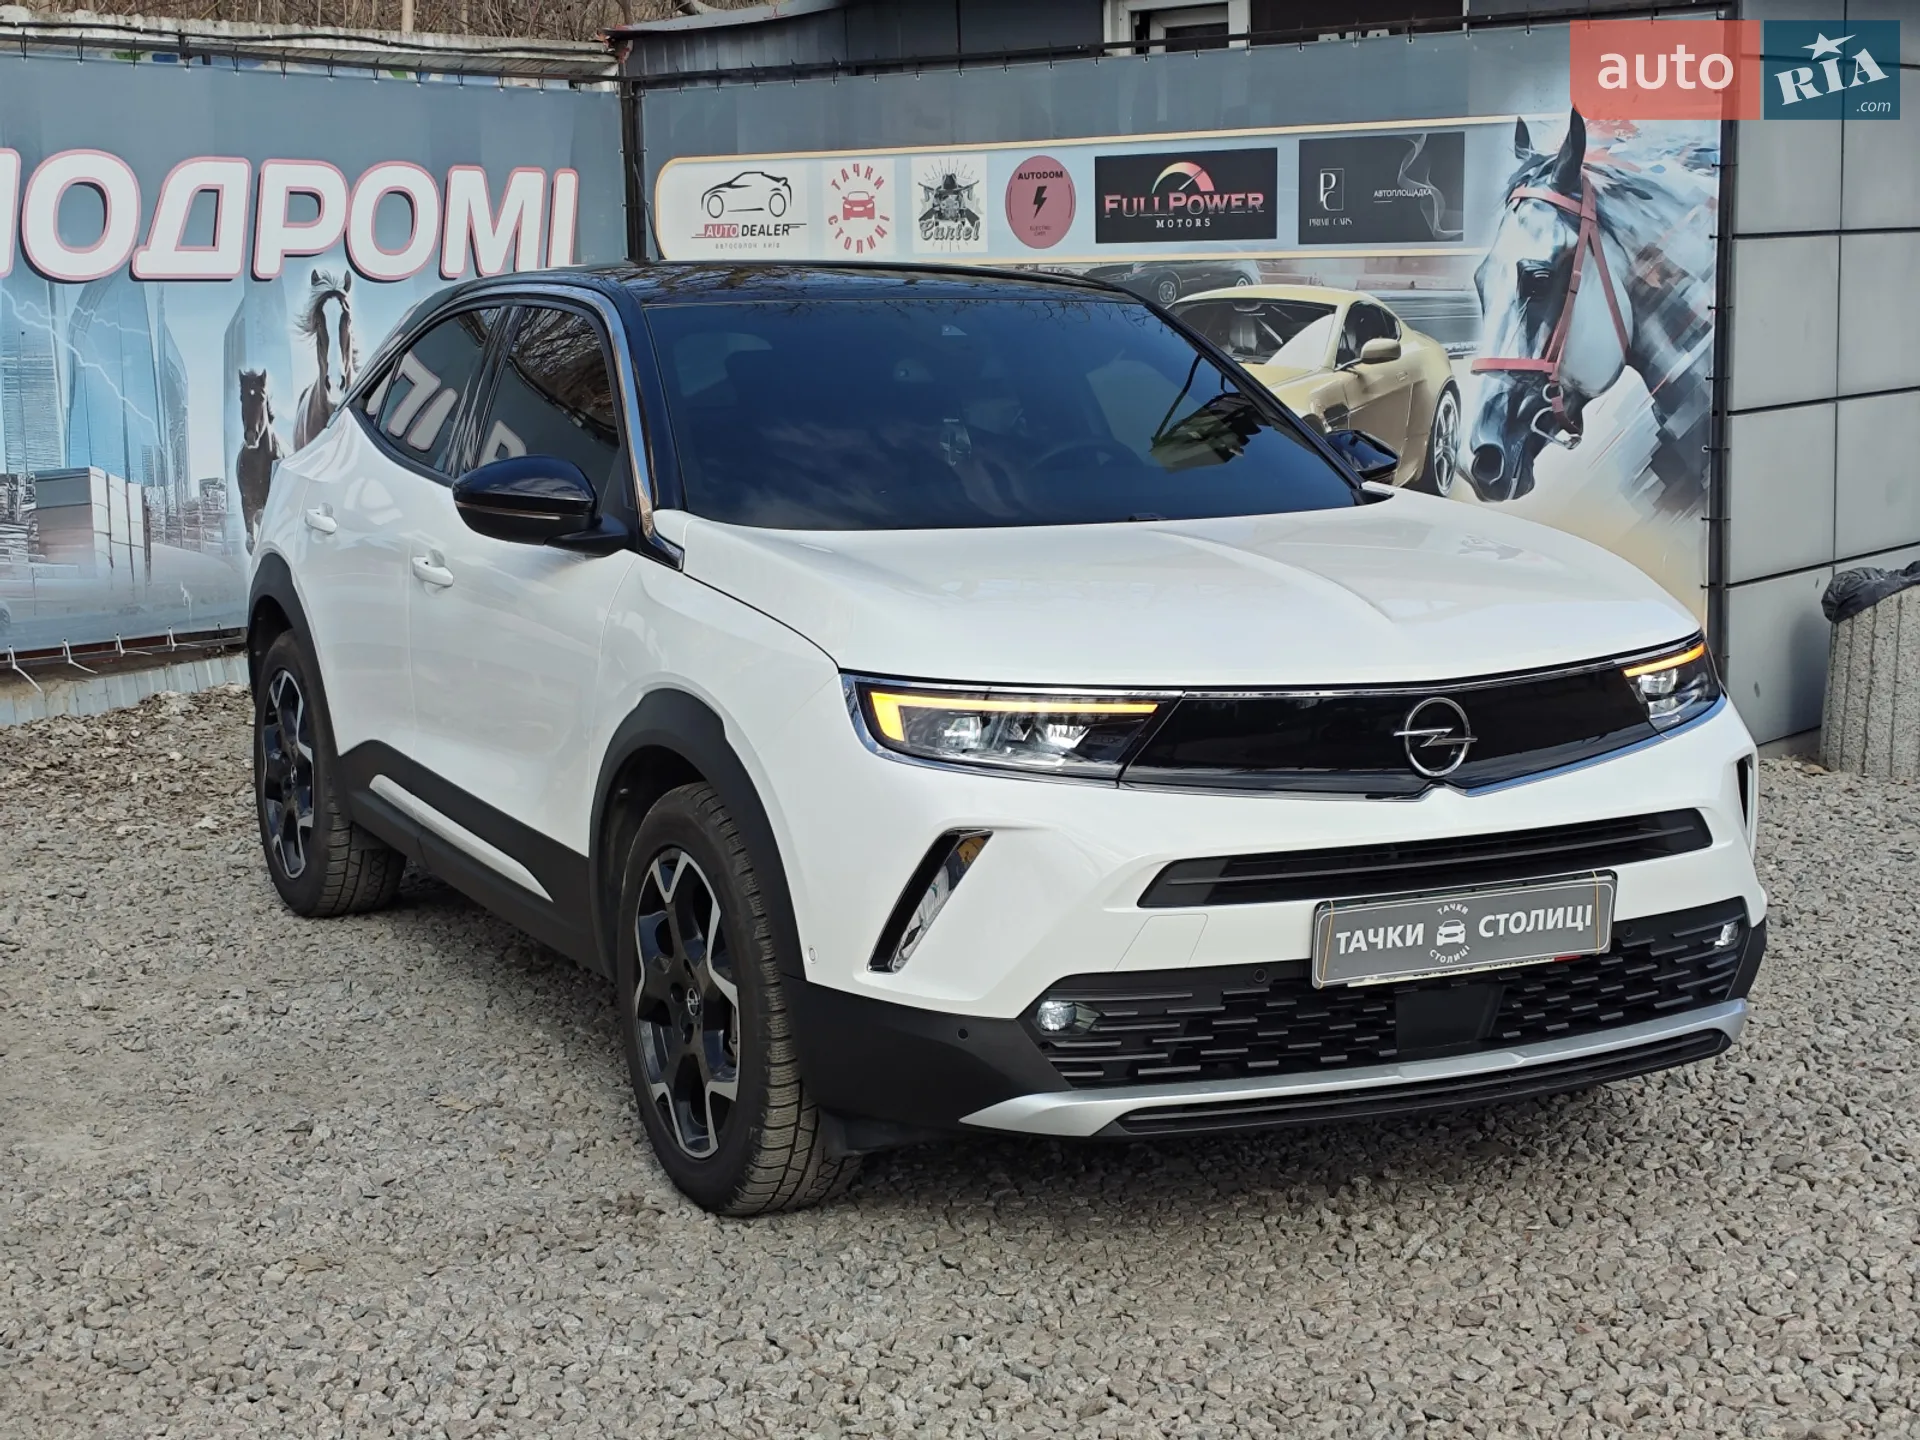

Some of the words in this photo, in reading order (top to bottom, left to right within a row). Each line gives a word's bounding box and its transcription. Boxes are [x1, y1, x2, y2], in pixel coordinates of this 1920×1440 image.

[831, 163, 885, 191] ТАЧКИ
[1017, 170, 1064, 180] AUTODOM
[1373, 188, 1432, 198] АВТОПЛОЩАДКА
[0, 148, 579, 282] ОДРОМІ
[1155, 218, 1211, 228] MOTORS
[705, 224, 738, 238] AUTO
[741, 223, 790, 236] DEALER
[828, 214, 890, 254] СТОЛИЦІ
[1436, 903, 1469, 915] ТАЧКИ
[1335, 923, 1425, 955] ТАЧКИ
[1478, 904, 1593, 939] СТОЛИЦІ
[1429, 945, 1471, 964] СТОЛИЦІ
